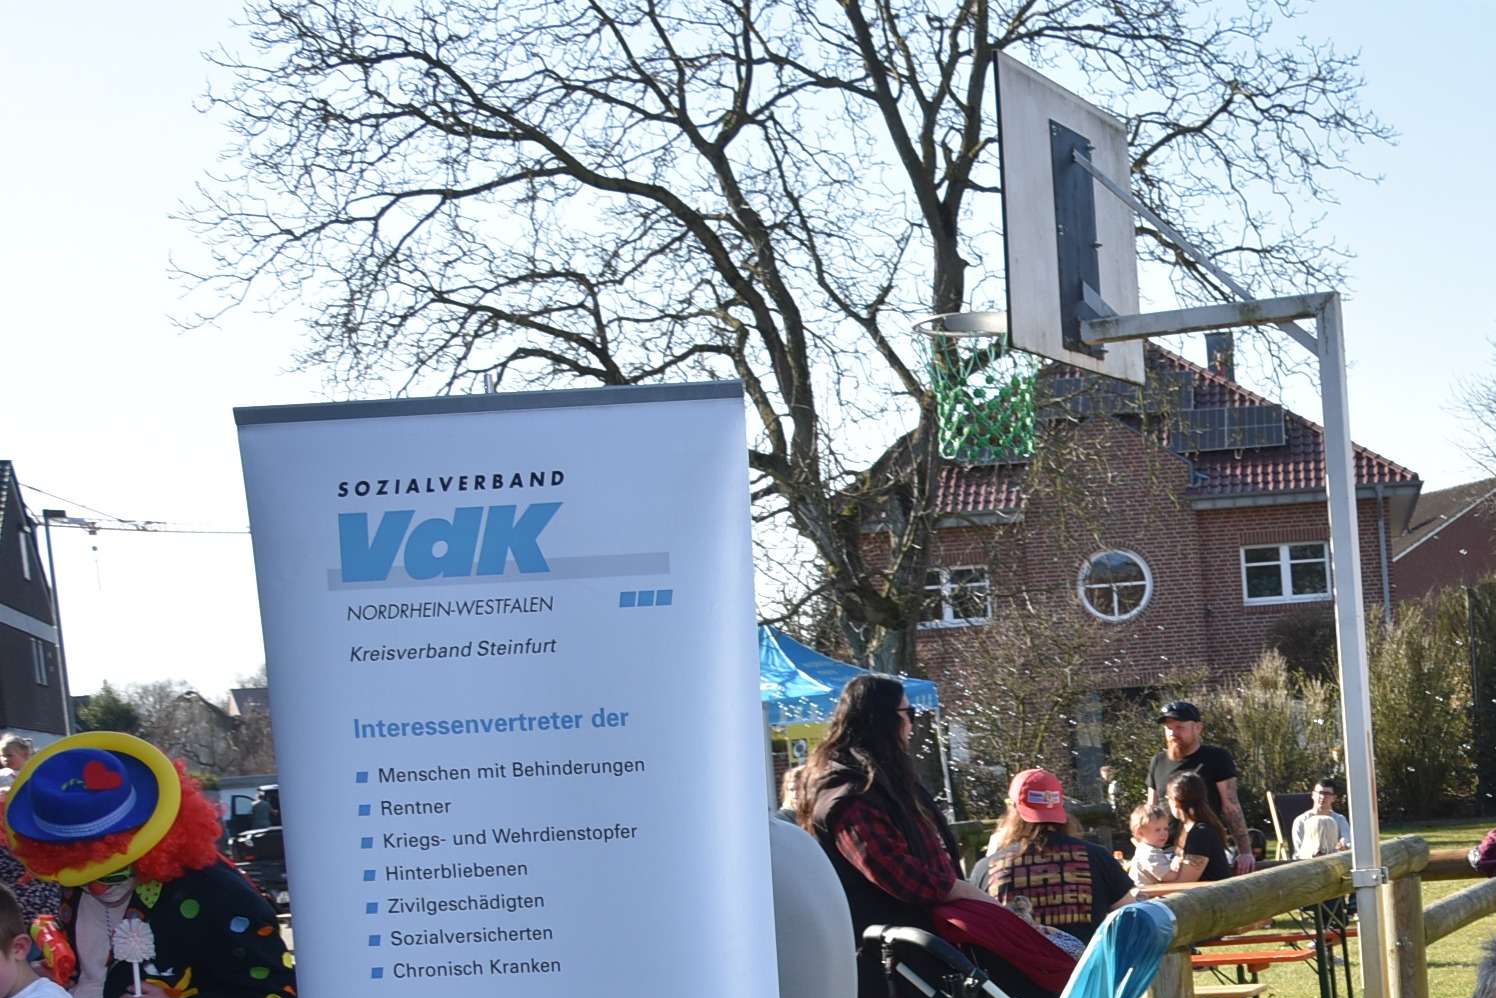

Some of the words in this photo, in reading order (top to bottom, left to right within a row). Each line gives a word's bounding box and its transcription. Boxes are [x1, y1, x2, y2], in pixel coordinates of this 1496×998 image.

[337, 470, 566, 498] SOZIALVERBAND
[337, 501, 565, 584] VdK
[346, 596, 554, 622] NORDRHEIN-WESTFALEN
[349, 640, 473, 663] Kreisverband
[477, 637, 558, 657] Steinfurt
[353, 709, 584, 739] Interessenvertreter
[590, 707, 630, 729] der
[377, 764, 471, 784] Menschen
[477, 761, 507, 779] mit
[512, 756, 646, 780] Behinderungen
[380, 798, 452, 816] Rentner
[382, 830, 447, 852] Kriegs-
[452, 828, 487, 847] und
[492, 822, 638, 847] Wehrdienstopfer
[385, 861, 529, 882] Hinterbliebenen
[387, 893, 545, 917] Zivilgeschädigten
[390, 926, 554, 947] Sozialversicherten
[392, 960, 484, 979] Chronisch
[489, 957, 562, 976] Kranken
